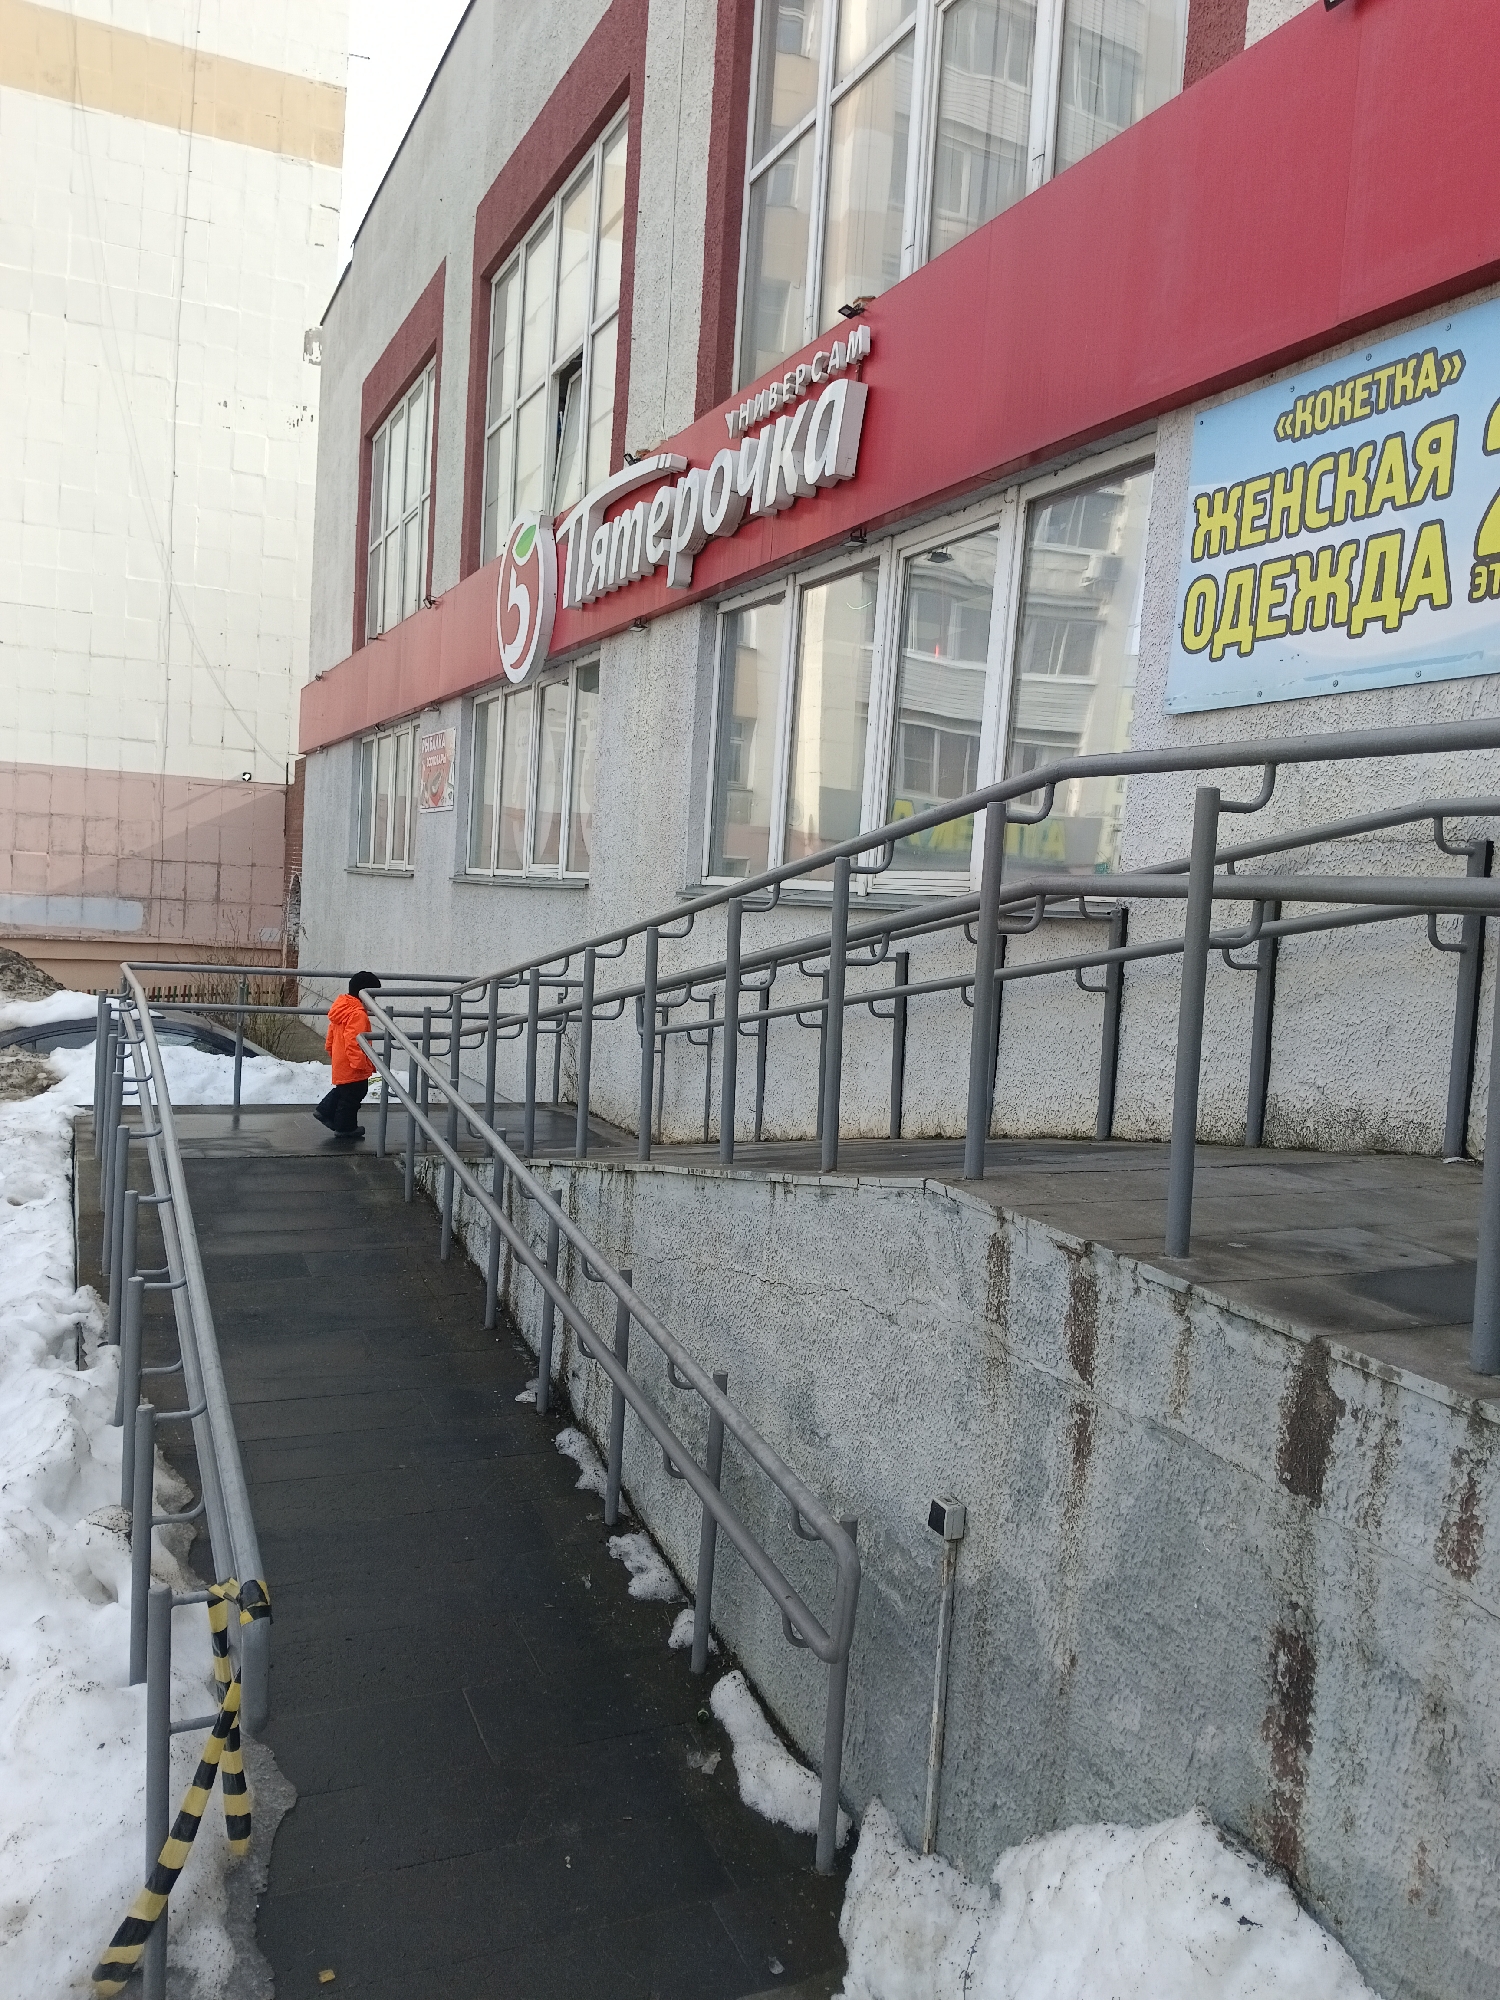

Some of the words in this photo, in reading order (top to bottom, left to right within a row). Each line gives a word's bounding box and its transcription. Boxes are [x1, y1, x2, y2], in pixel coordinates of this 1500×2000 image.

[725, 324, 871, 440] УНИВЕРСАМ
[1274, 347, 1466, 443] «КОКЕТКА»
[1191, 414, 1459, 563] ЖЕНСКАЯ
[1181, 519, 1451, 661] ОДЕЖДА
